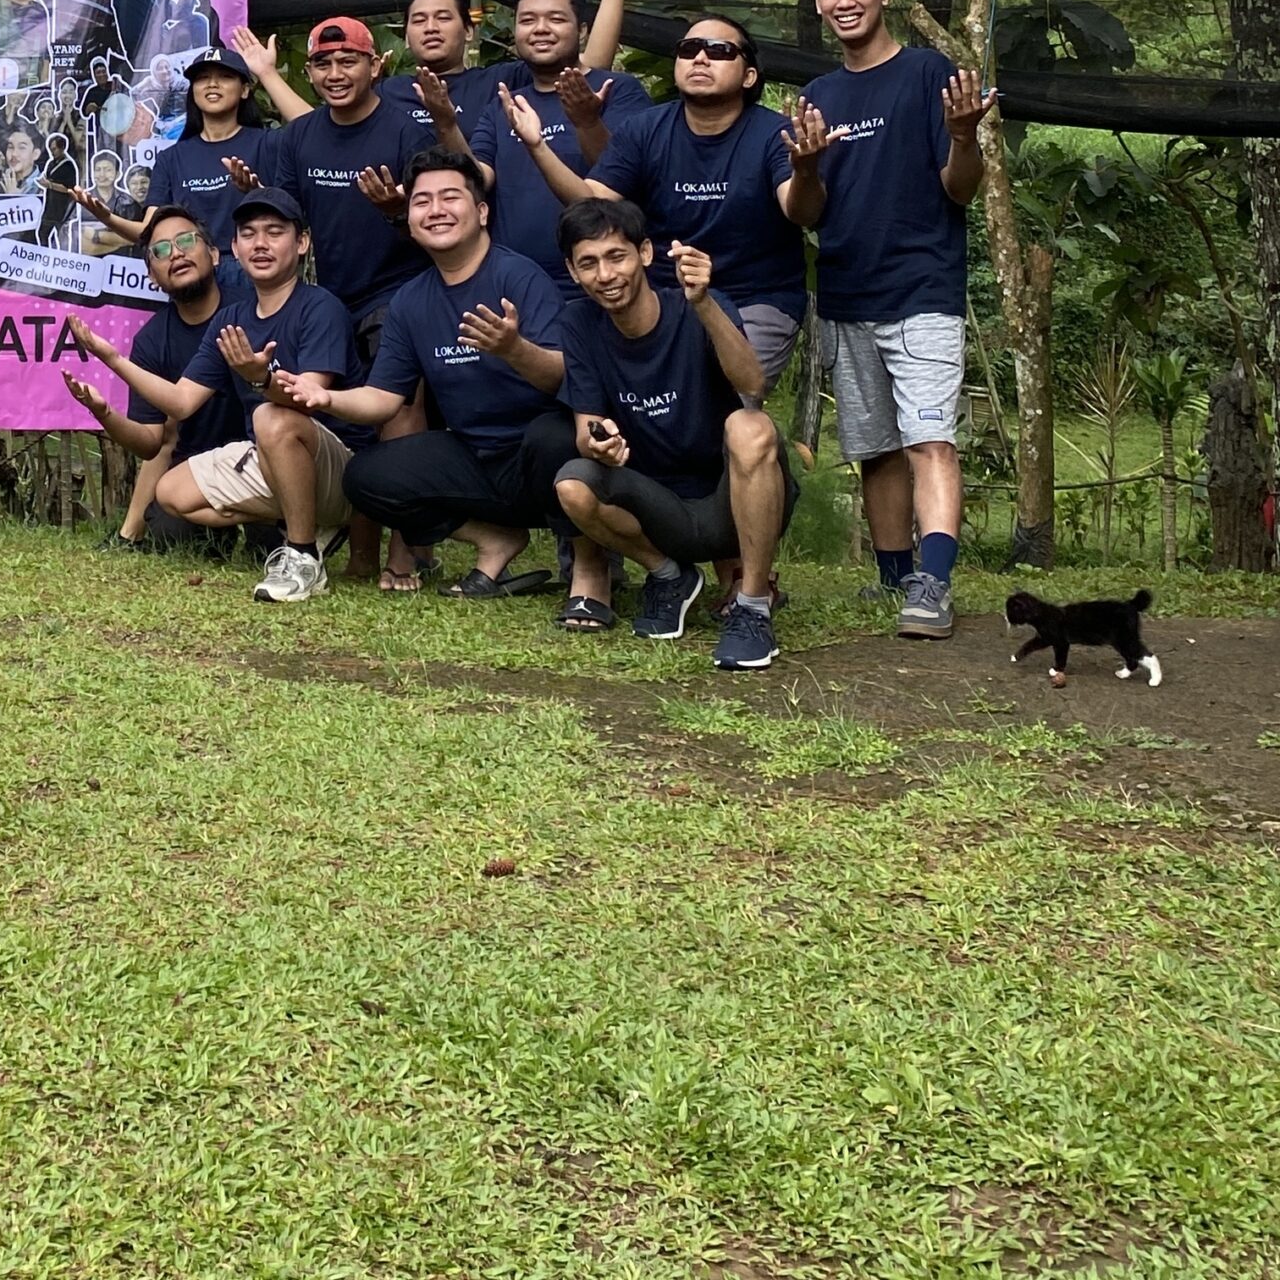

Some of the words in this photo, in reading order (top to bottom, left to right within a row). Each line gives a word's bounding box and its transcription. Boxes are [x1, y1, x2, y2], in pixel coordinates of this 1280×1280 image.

[10, 245, 50, 267] Abang
[52, 255, 91, 273] pesen
[25, 267, 53, 283] dulu
